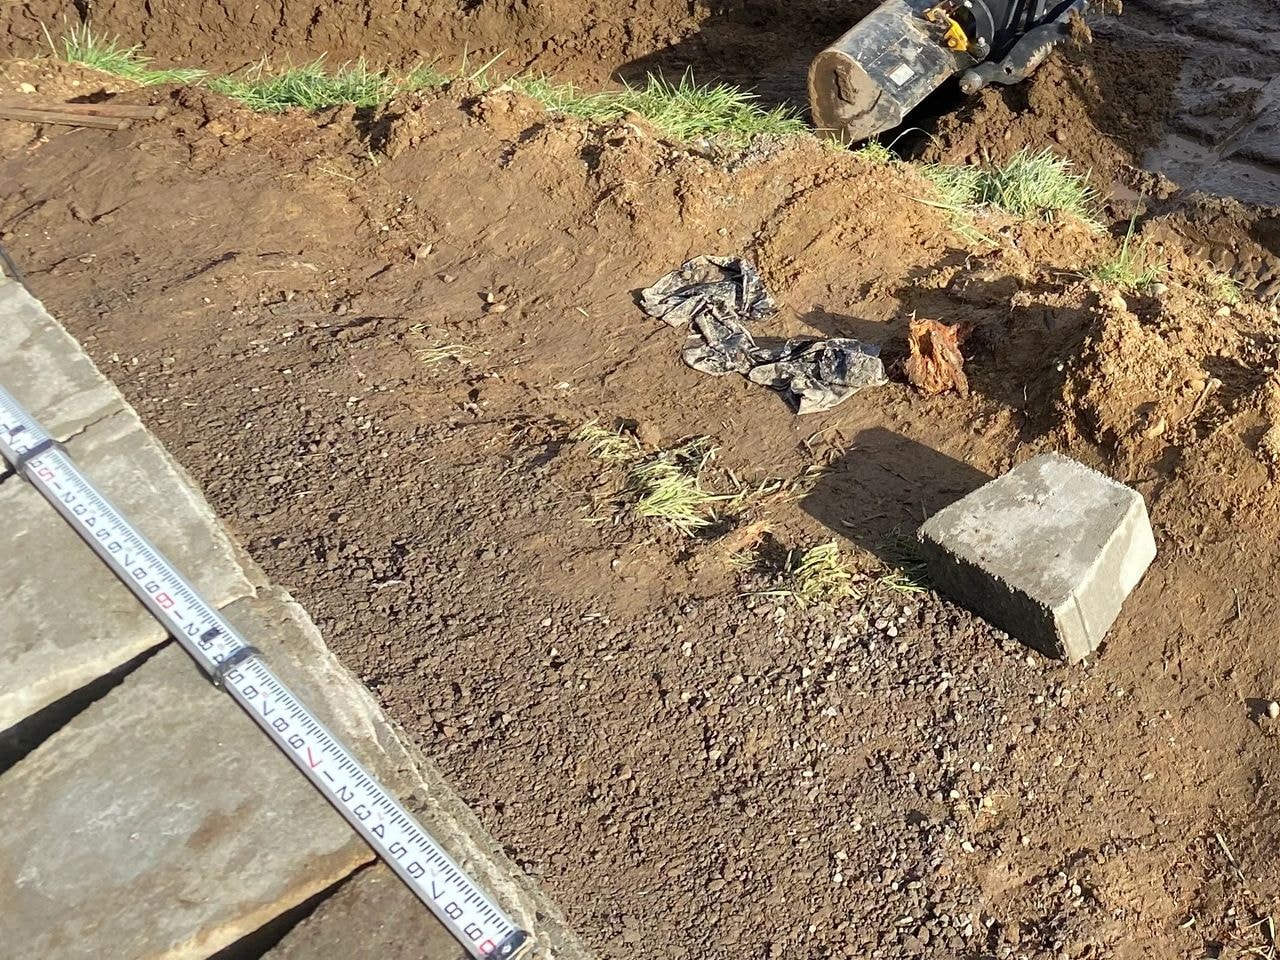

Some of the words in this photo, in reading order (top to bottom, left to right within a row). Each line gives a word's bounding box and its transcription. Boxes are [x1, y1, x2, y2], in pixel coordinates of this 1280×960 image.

[96, 528, 110, 540] 5
[132, 567, 147, 580] 8
[184, 622, 199, 636] 2
[228, 669, 244, 684] 5
[263, 700, 275, 716] 7
[272, 717, 289, 732] 8
[307, 746, 323, 768] 7
[336, 786, 354, 802] 2
[353, 804, 371, 821] 3
[372, 824, 385, 839] 4
[388, 842, 407, 859] 5
[432, 880, 446, 900] 7
[444, 901, 464, 920] 8
